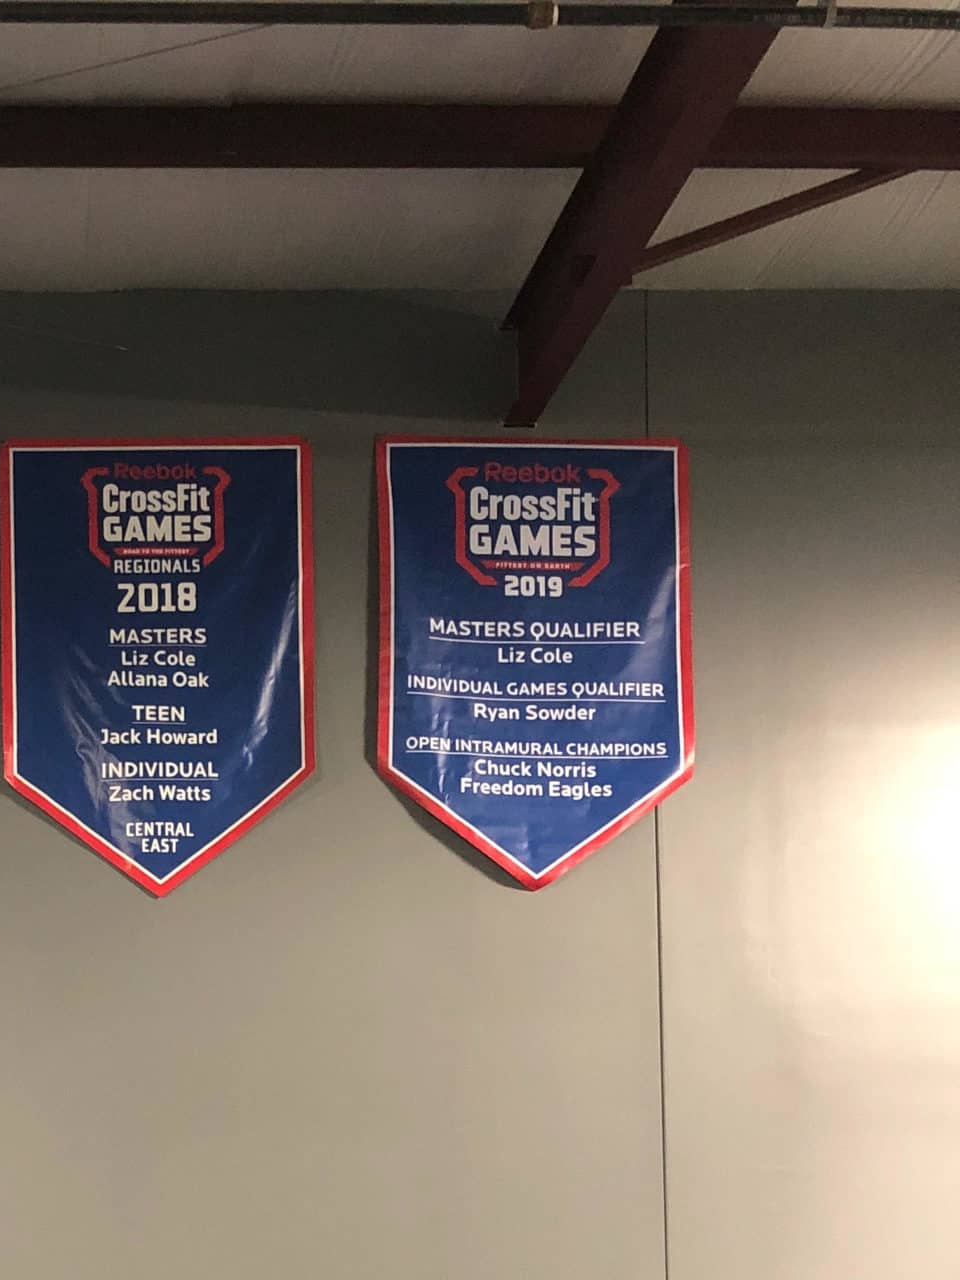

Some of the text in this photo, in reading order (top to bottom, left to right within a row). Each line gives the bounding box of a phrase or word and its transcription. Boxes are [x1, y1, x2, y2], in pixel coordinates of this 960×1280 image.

[114, 462, 197, 479] Reebok
[484, 462, 581, 483] Reebok
[102, 483, 210, 512] CrossFit
[469, 486, 596, 521] CrossFit
[103, 515, 212, 542] GAMES
[469, 524, 596, 557] GAMES
[114, 559, 200, 573] REGIONALS
[504, 575, 563, 597] 2019
[117, 582, 197, 613] 2018
[110, 628, 207, 644] MASTERS
[429, 618, 641, 640] MASTERS QUALIFIER
[121, 650, 196, 667] Liz Cole
[497, 648, 573, 664] Liz Cole
[108, 671, 209, 688] Allana Oak
[407, 675, 664, 698] INDIVIDUAL GAMES QUALIFIER
[132, 705, 185, 722] TEEN
[474, 704, 596, 723] Ryan Sowder
[101, 728, 218, 745] Jack Howard
[406, 737, 666, 756] OPEN INTRAMURAL CHAMPIONS
[101, 762, 219, 779] INDIVIDUAL
[474, 760, 597, 778] Chuck Norris
[109, 785, 211, 802] Zach Watts
[460, 779, 613, 799] Freedom Eagles
[126, 821, 194, 837] CENTRAL
[142, 838, 179, 853] EAST
